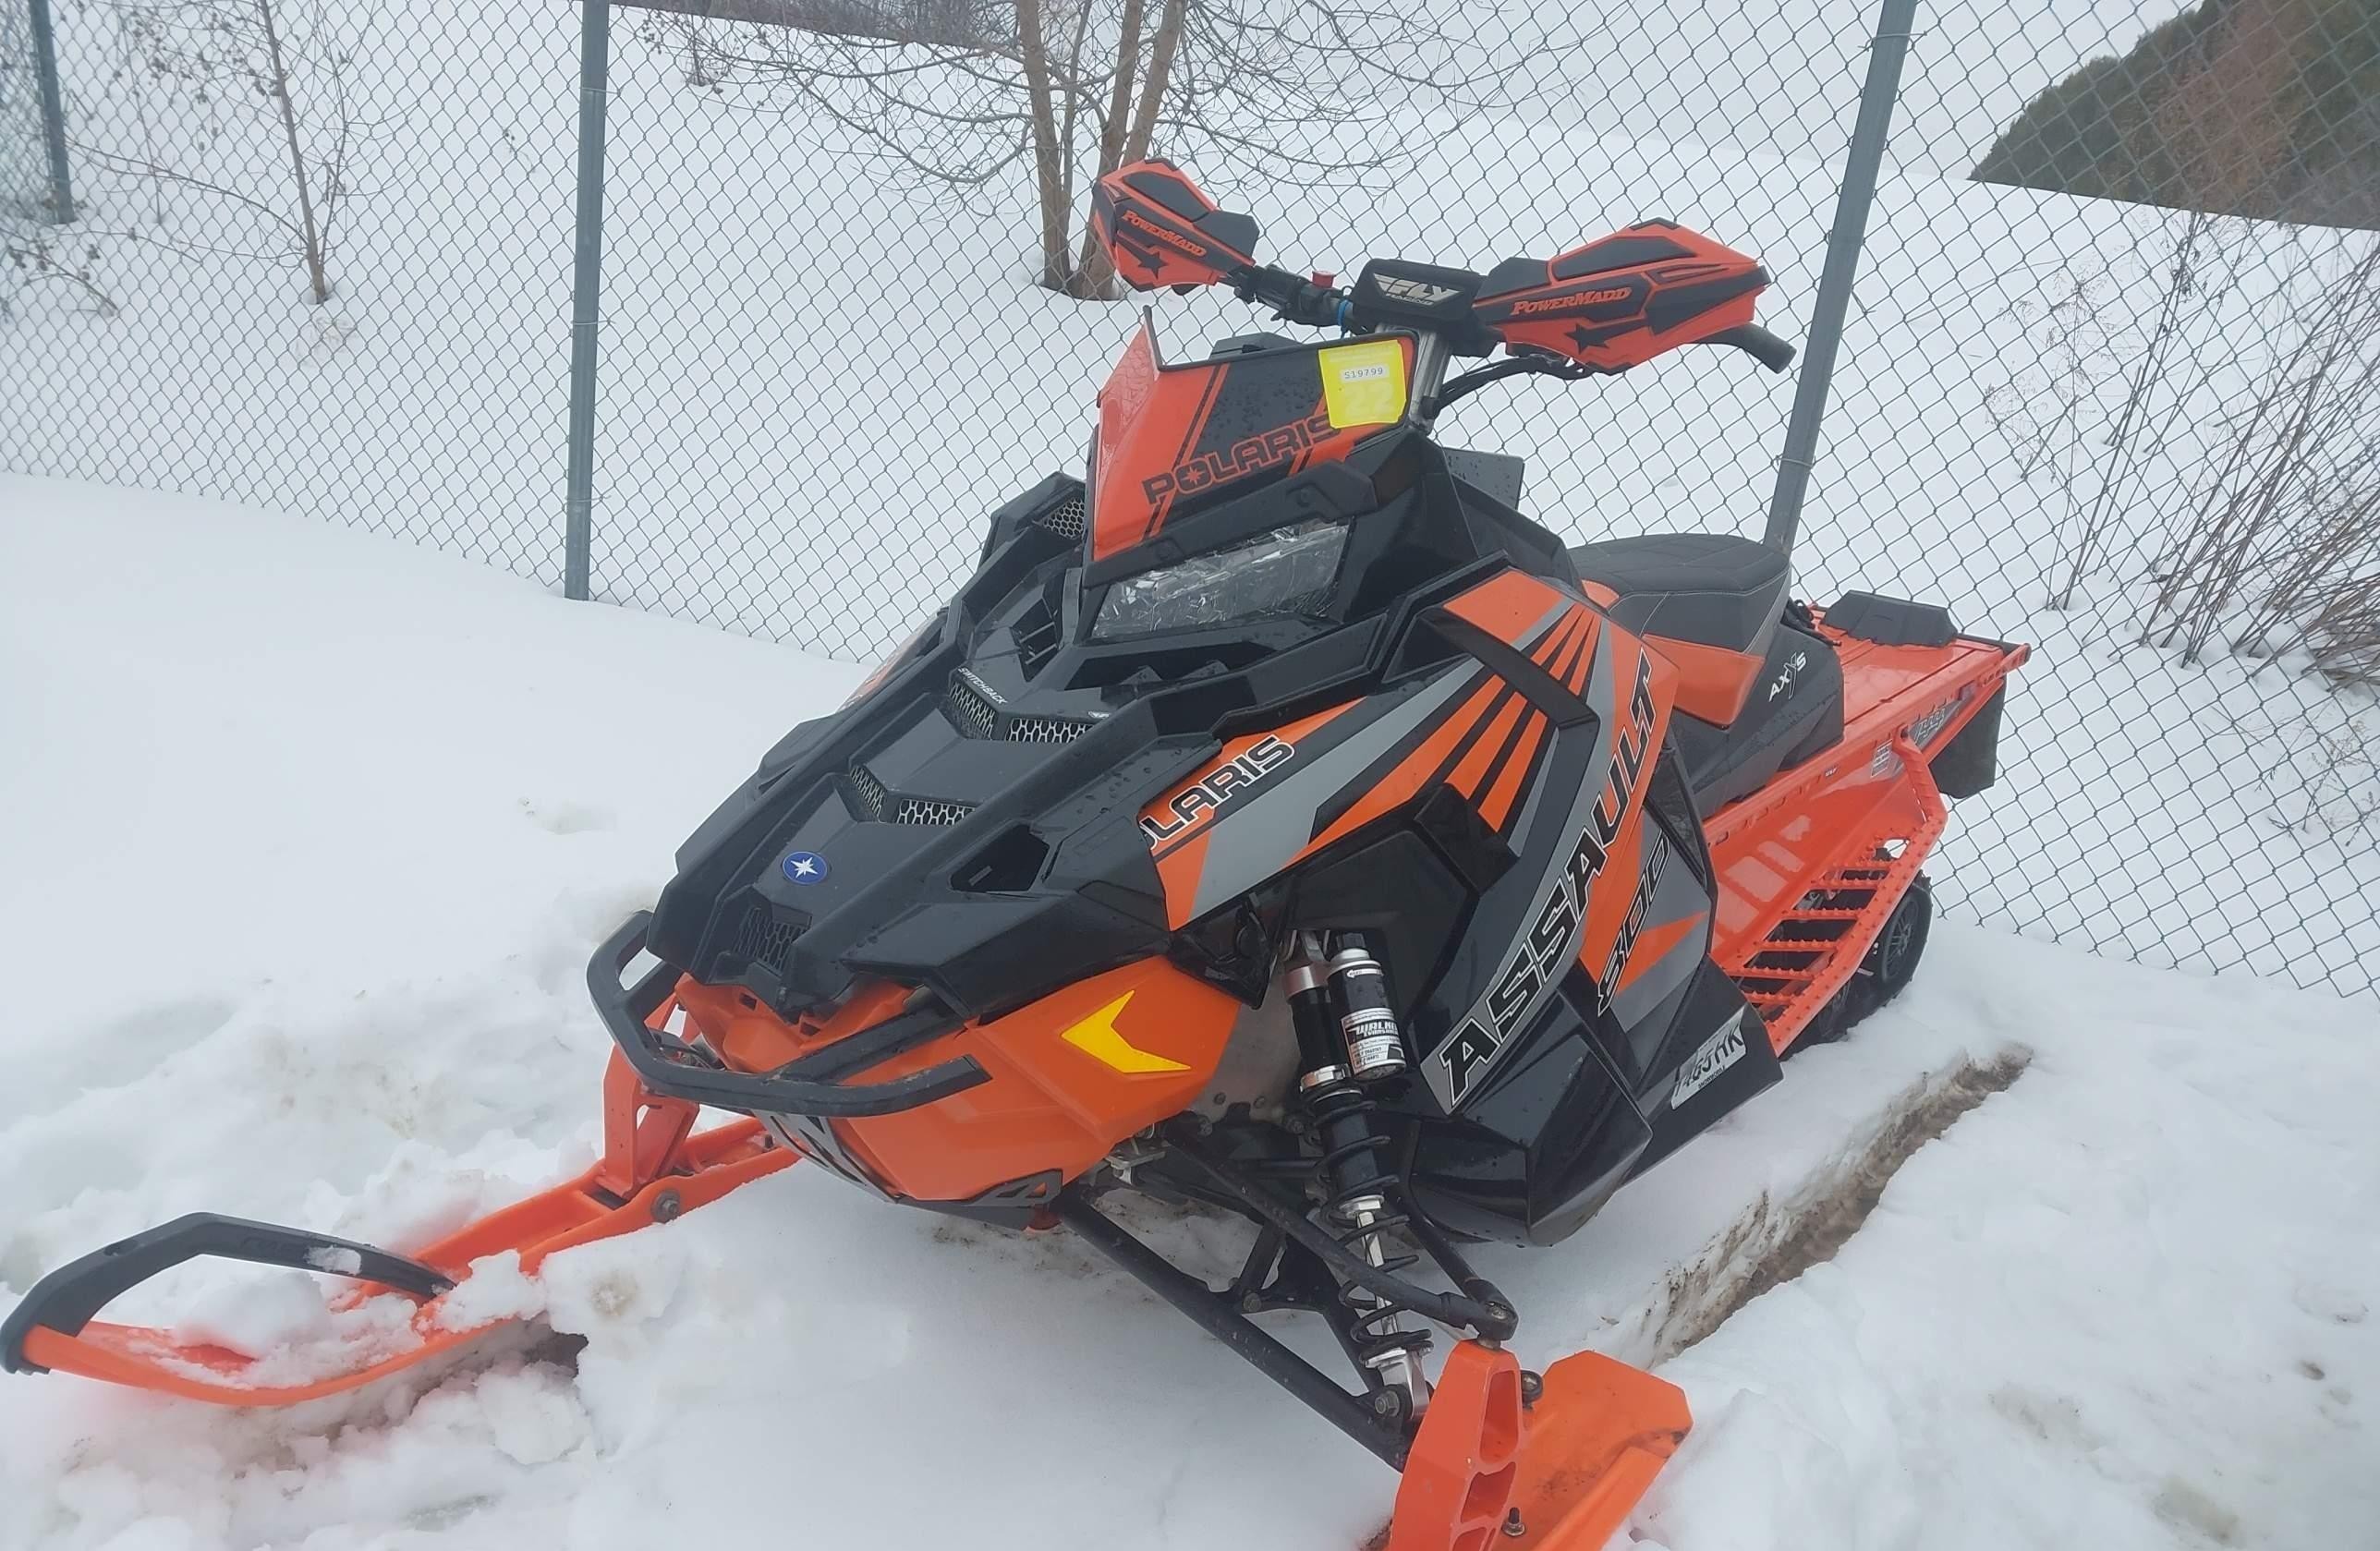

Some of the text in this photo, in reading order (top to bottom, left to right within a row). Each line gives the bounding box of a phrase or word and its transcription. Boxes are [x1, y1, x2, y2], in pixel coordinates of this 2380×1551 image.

[1373, 273, 1460, 302] FLY
[1510, 286, 1633, 316] POWERMADD
[1141, 413, 1342, 508] POLARIS
[957, 666, 1009, 705] SWITCHBACK
[1439, 646, 1657, 1109] ASSAULT
